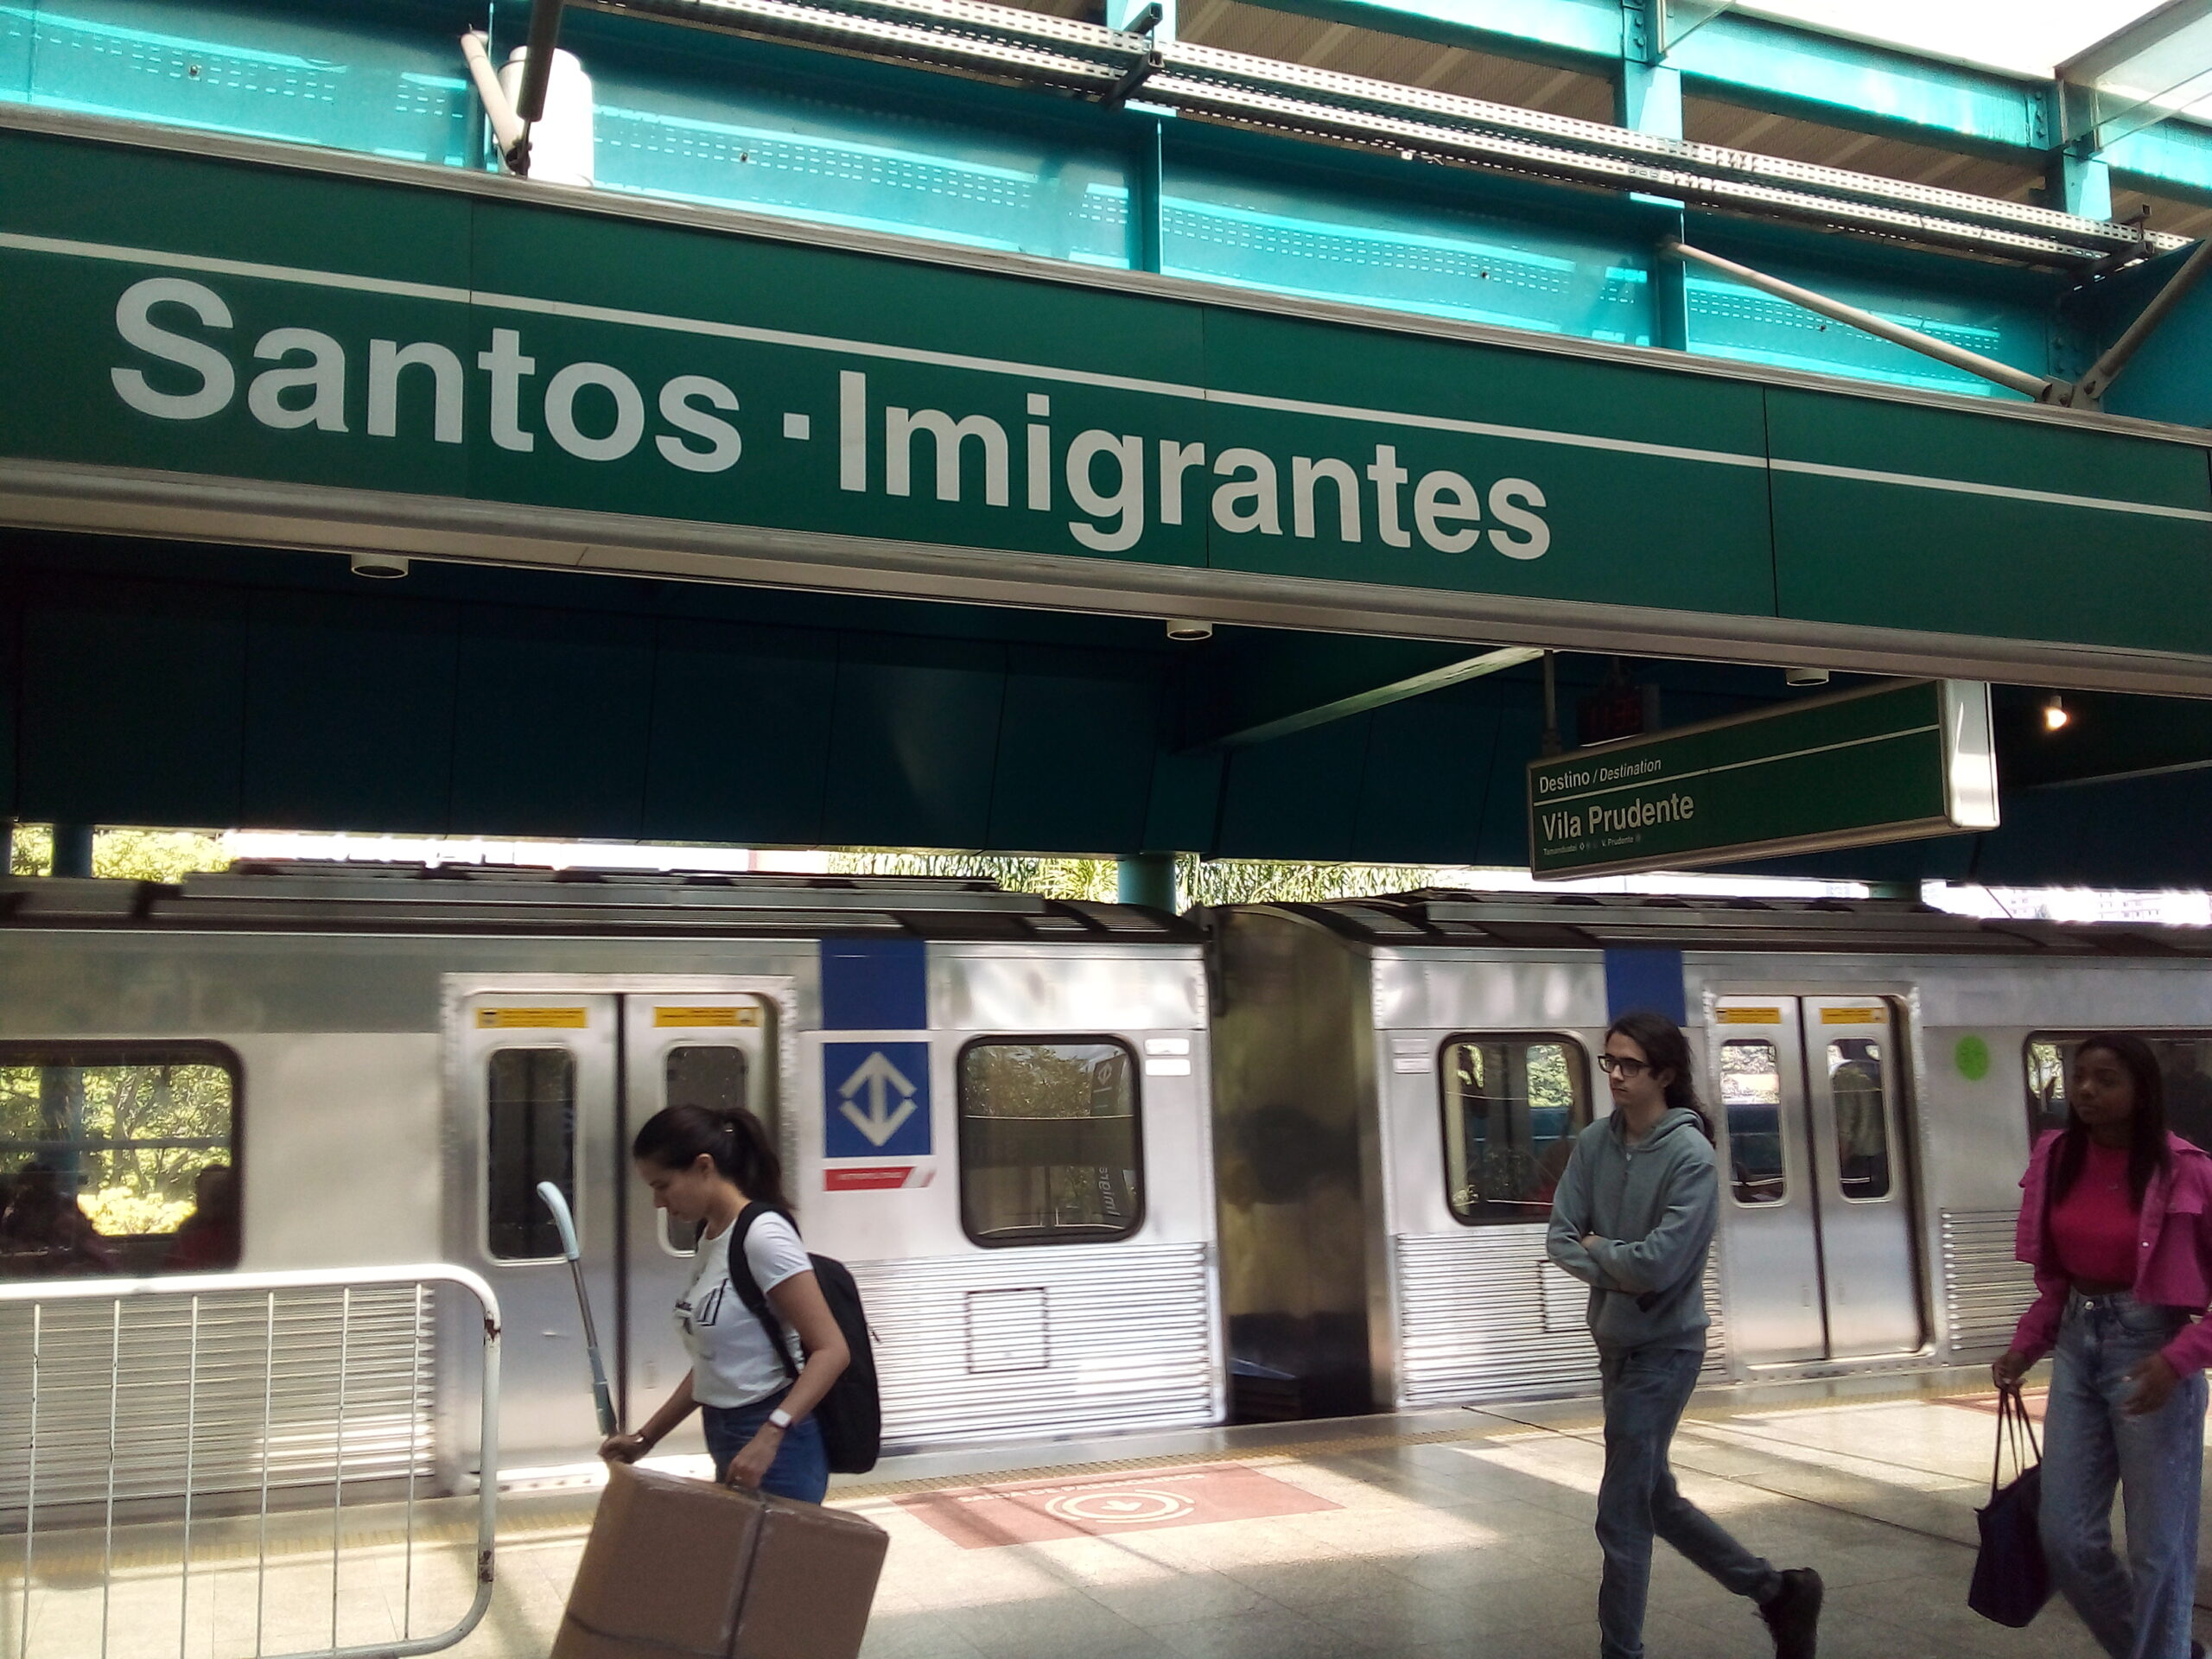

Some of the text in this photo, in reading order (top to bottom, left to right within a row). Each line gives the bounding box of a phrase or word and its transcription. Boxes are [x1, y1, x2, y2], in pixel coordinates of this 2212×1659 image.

[111, 277, 741, 473] Santos
[840, 370, 1551, 561] Imigrantes
[1540, 771, 1590, 794] Destino
[1599, 759, 1662, 782] Destination
[1541, 792, 1694, 842] Vila Prudente
